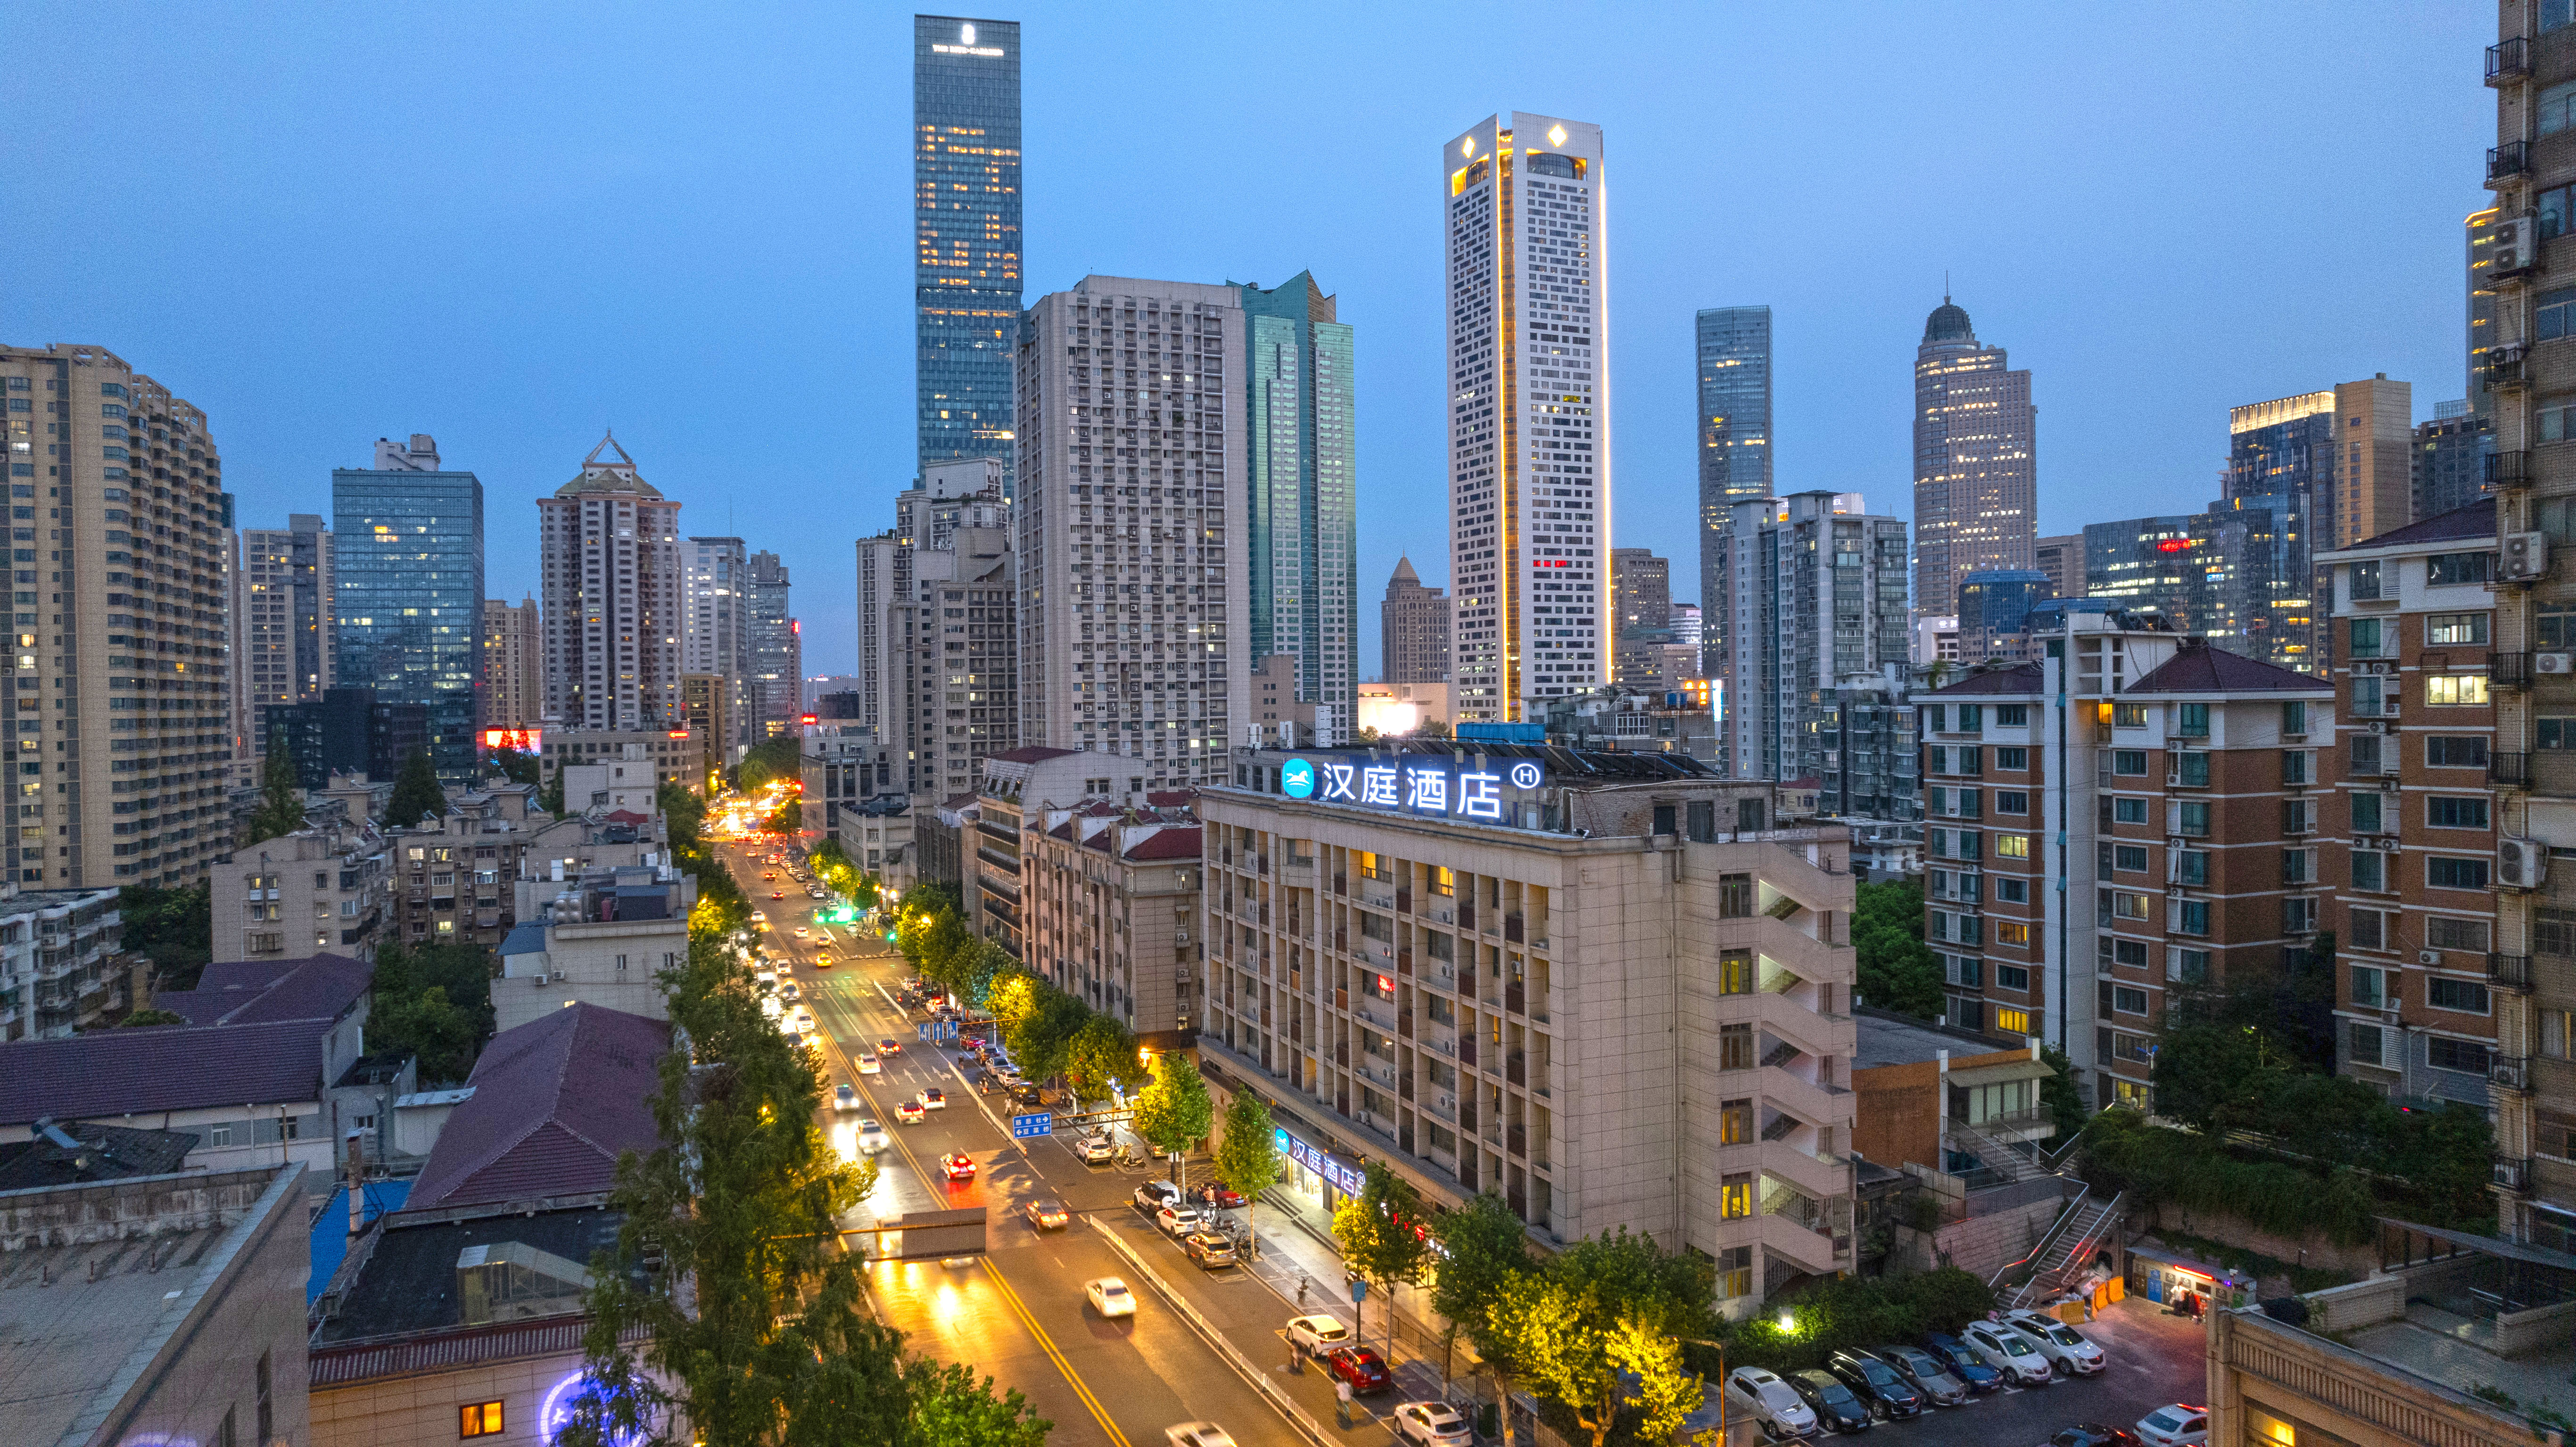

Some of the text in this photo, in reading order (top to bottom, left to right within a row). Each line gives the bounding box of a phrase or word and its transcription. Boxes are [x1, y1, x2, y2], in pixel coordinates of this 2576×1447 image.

[1323, 762, 1501, 818] 汉庭酒店
[1023, 1126, 1049, 1135] 豆菜桥
[1293, 1138, 1354, 1194] 汉庭酒店
